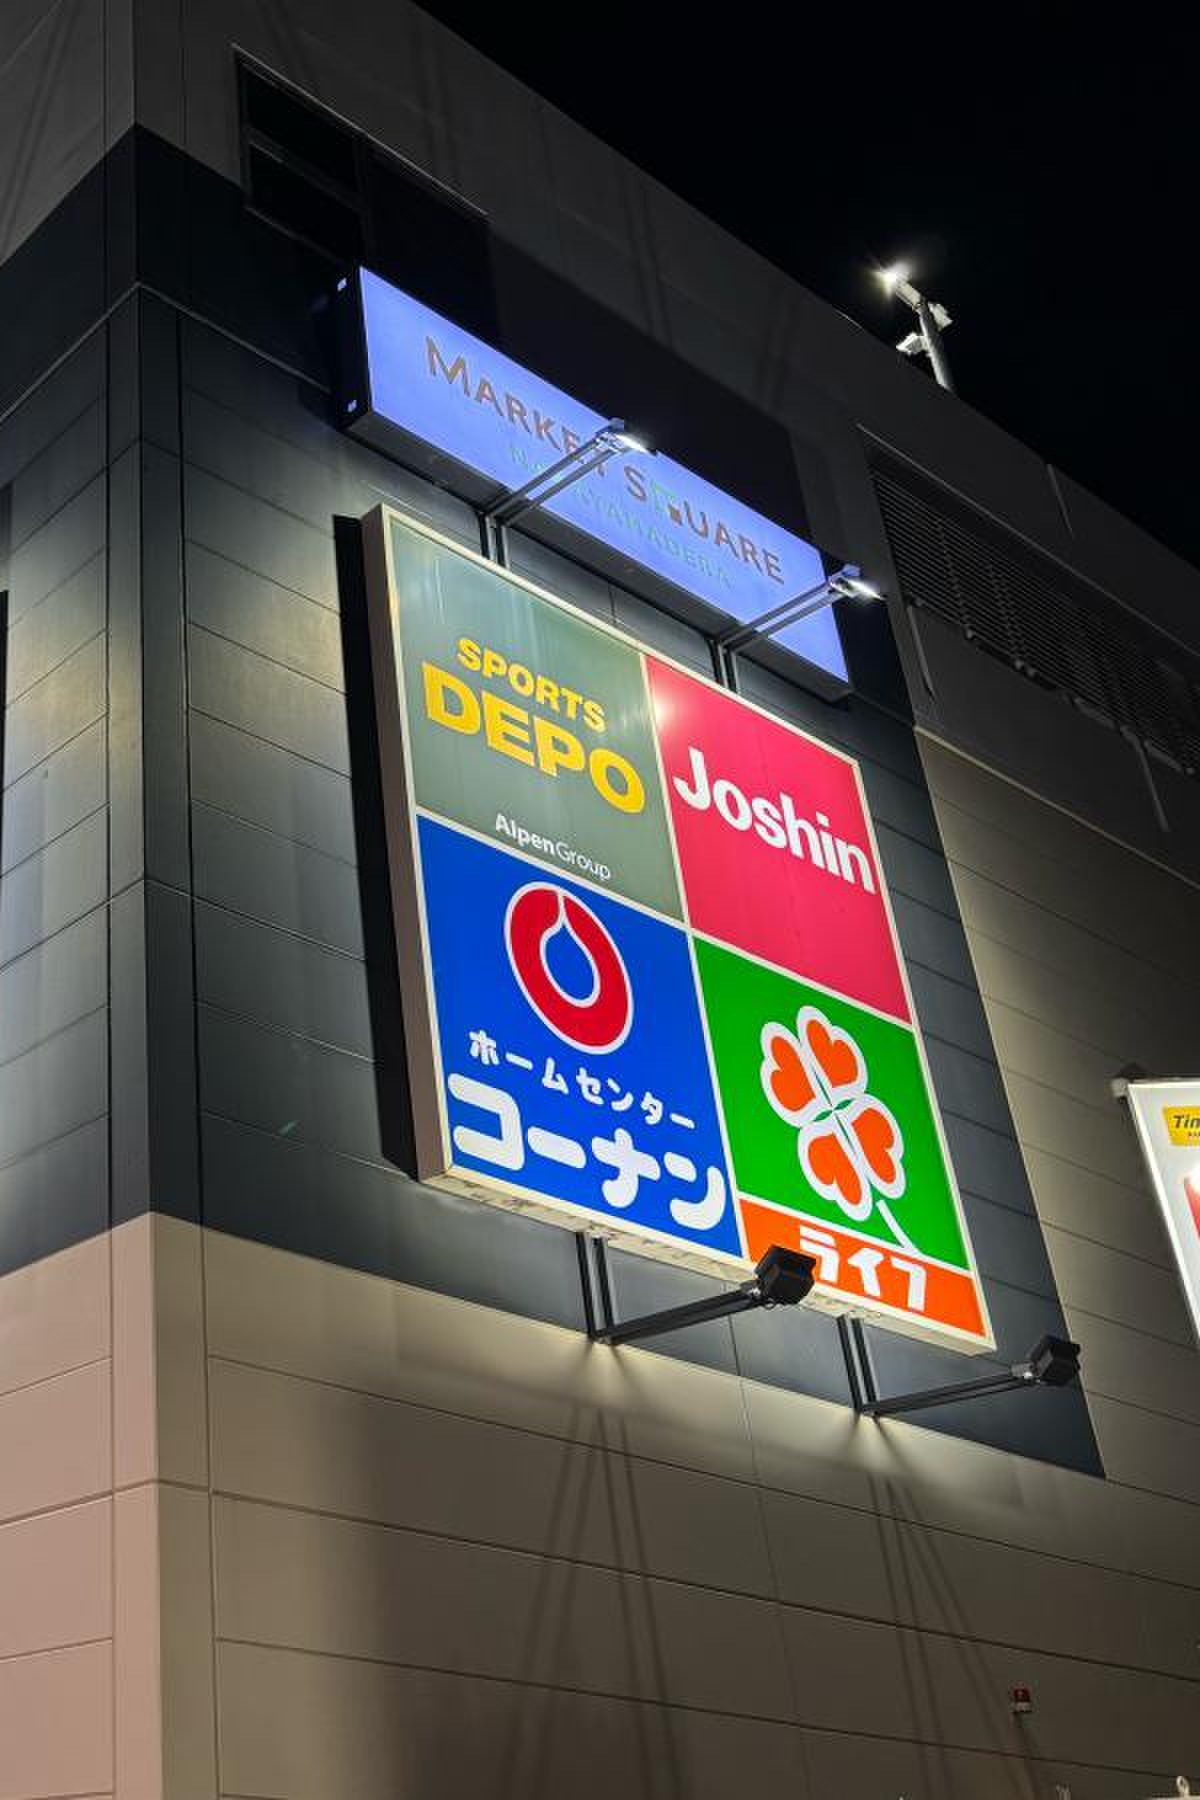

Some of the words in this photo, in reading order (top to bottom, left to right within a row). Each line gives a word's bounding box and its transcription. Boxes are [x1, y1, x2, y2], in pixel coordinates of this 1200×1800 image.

[422, 661, 645, 813] DEPO
[457, 637, 606, 733] SPORTS
[673, 745, 876, 894] Joshin
[469, 1029, 695, 1130] ホームセンター
[447, 1072, 726, 1231] コーナン
[799, 1224, 927, 1313] ライフ
